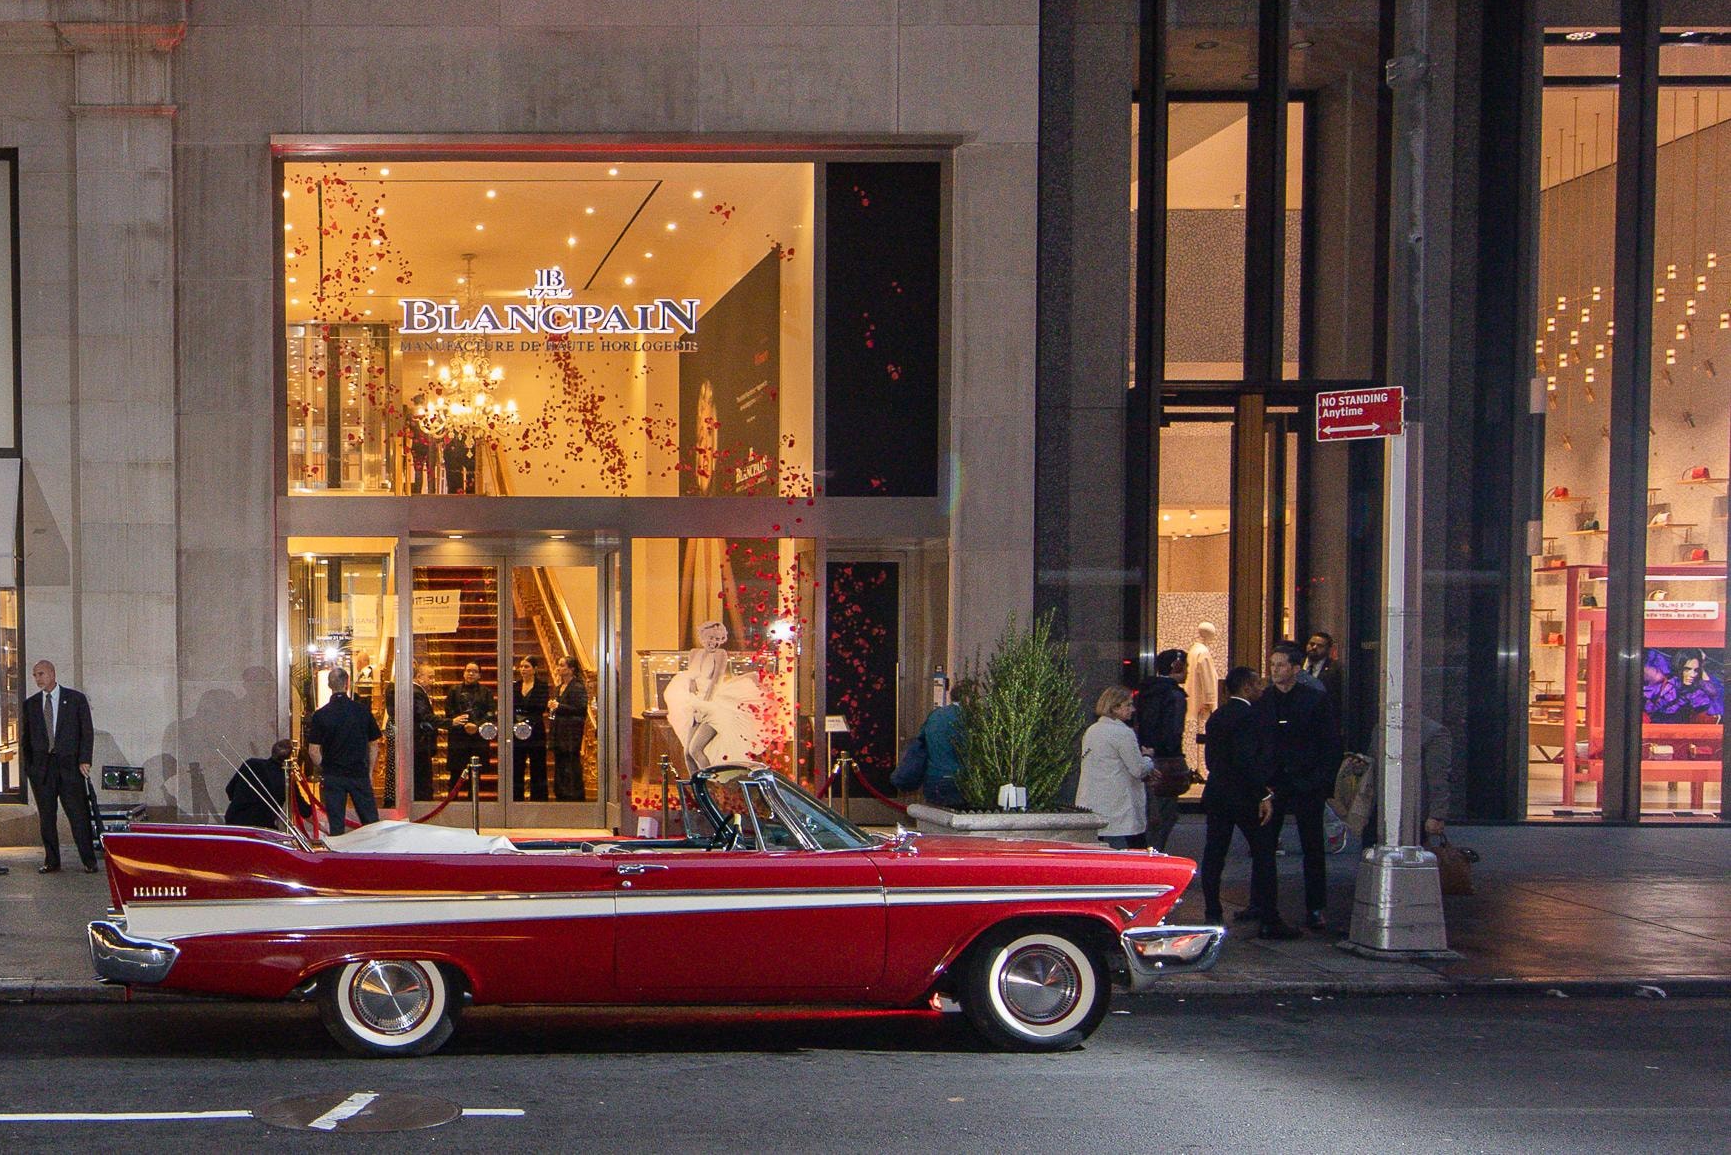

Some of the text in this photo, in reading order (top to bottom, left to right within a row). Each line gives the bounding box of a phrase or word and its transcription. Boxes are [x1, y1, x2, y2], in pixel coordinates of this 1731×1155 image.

[398, 298, 702, 334] BLANCPAIN
[399, 340, 700, 353] MANUFACTURE DE HAUTE HORLOGERIE
[1321, 392, 1388, 407] NO STANDING
[1321, 406, 1364, 419] Anytime
